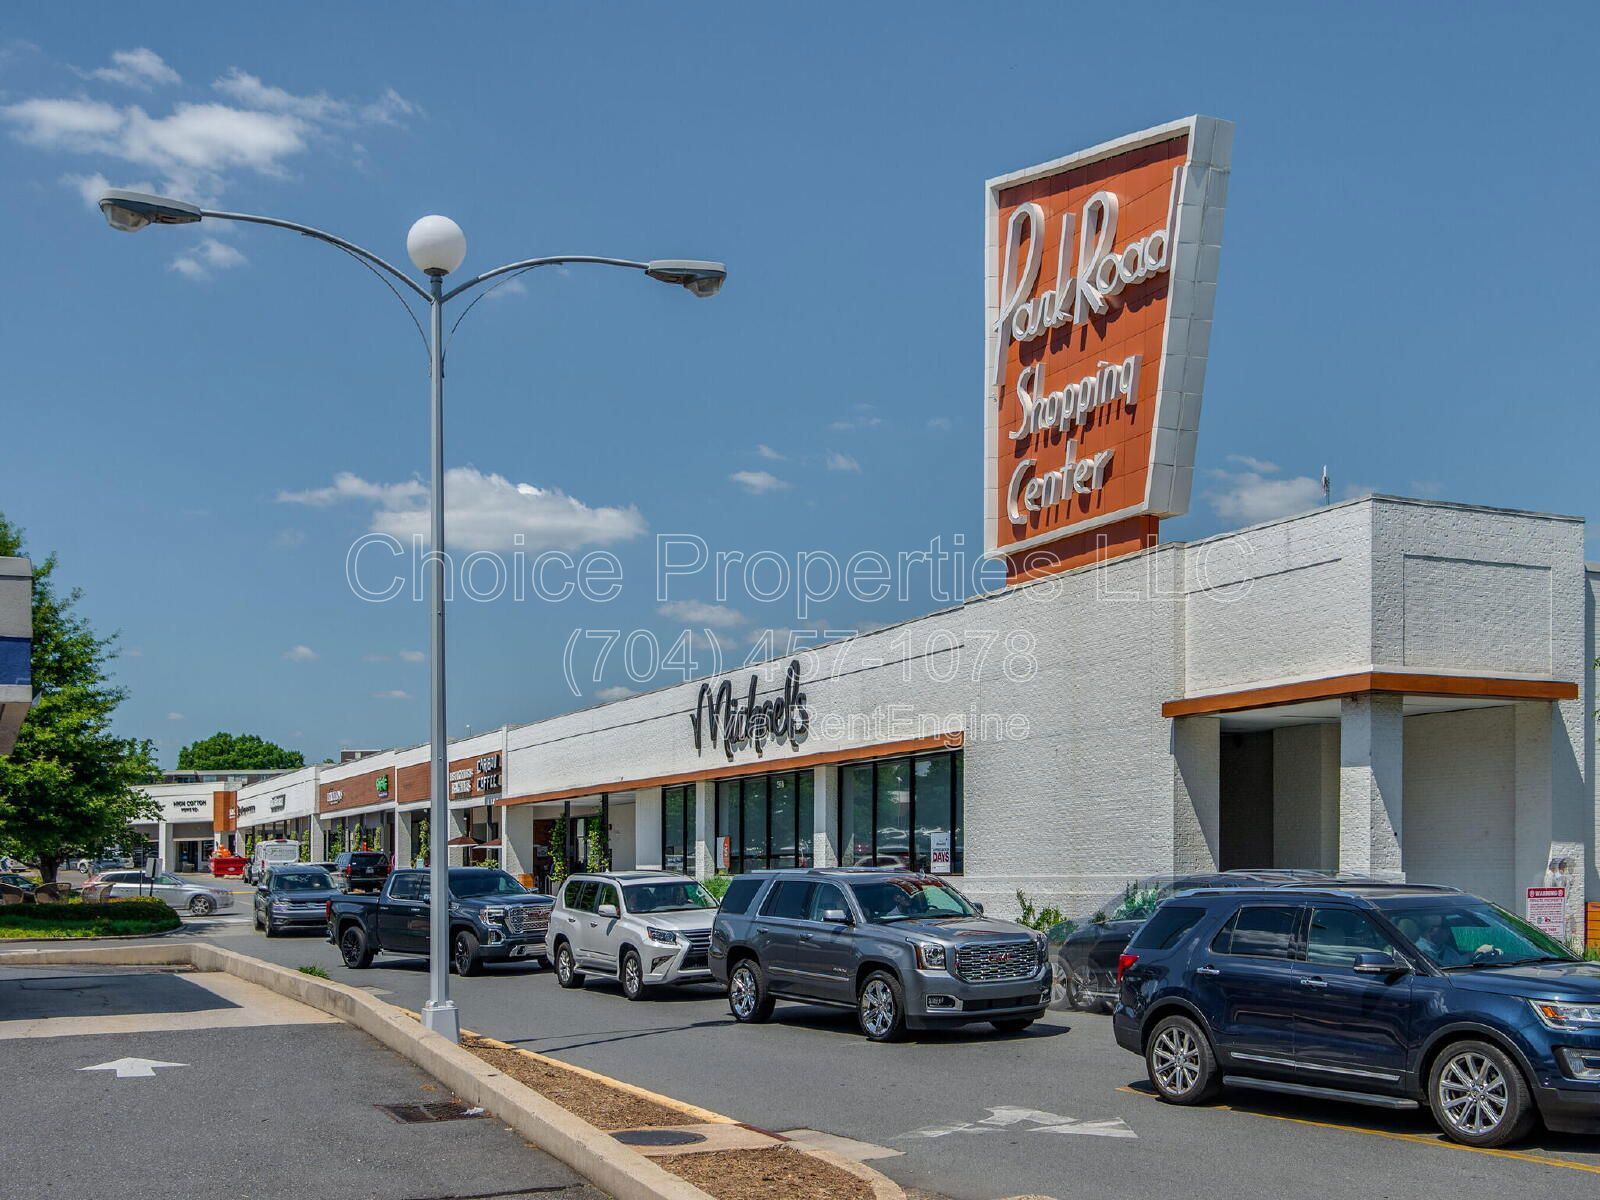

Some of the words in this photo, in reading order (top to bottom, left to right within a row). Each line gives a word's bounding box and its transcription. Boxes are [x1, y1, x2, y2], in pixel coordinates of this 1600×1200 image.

[993, 202, 1078, 387] Park
[1074, 166, 1184, 325] Road
[1009, 357, 1143, 440] Shopping
[1007, 438, 1115, 525] Center
[933, 852, 949, 862] DAYS
